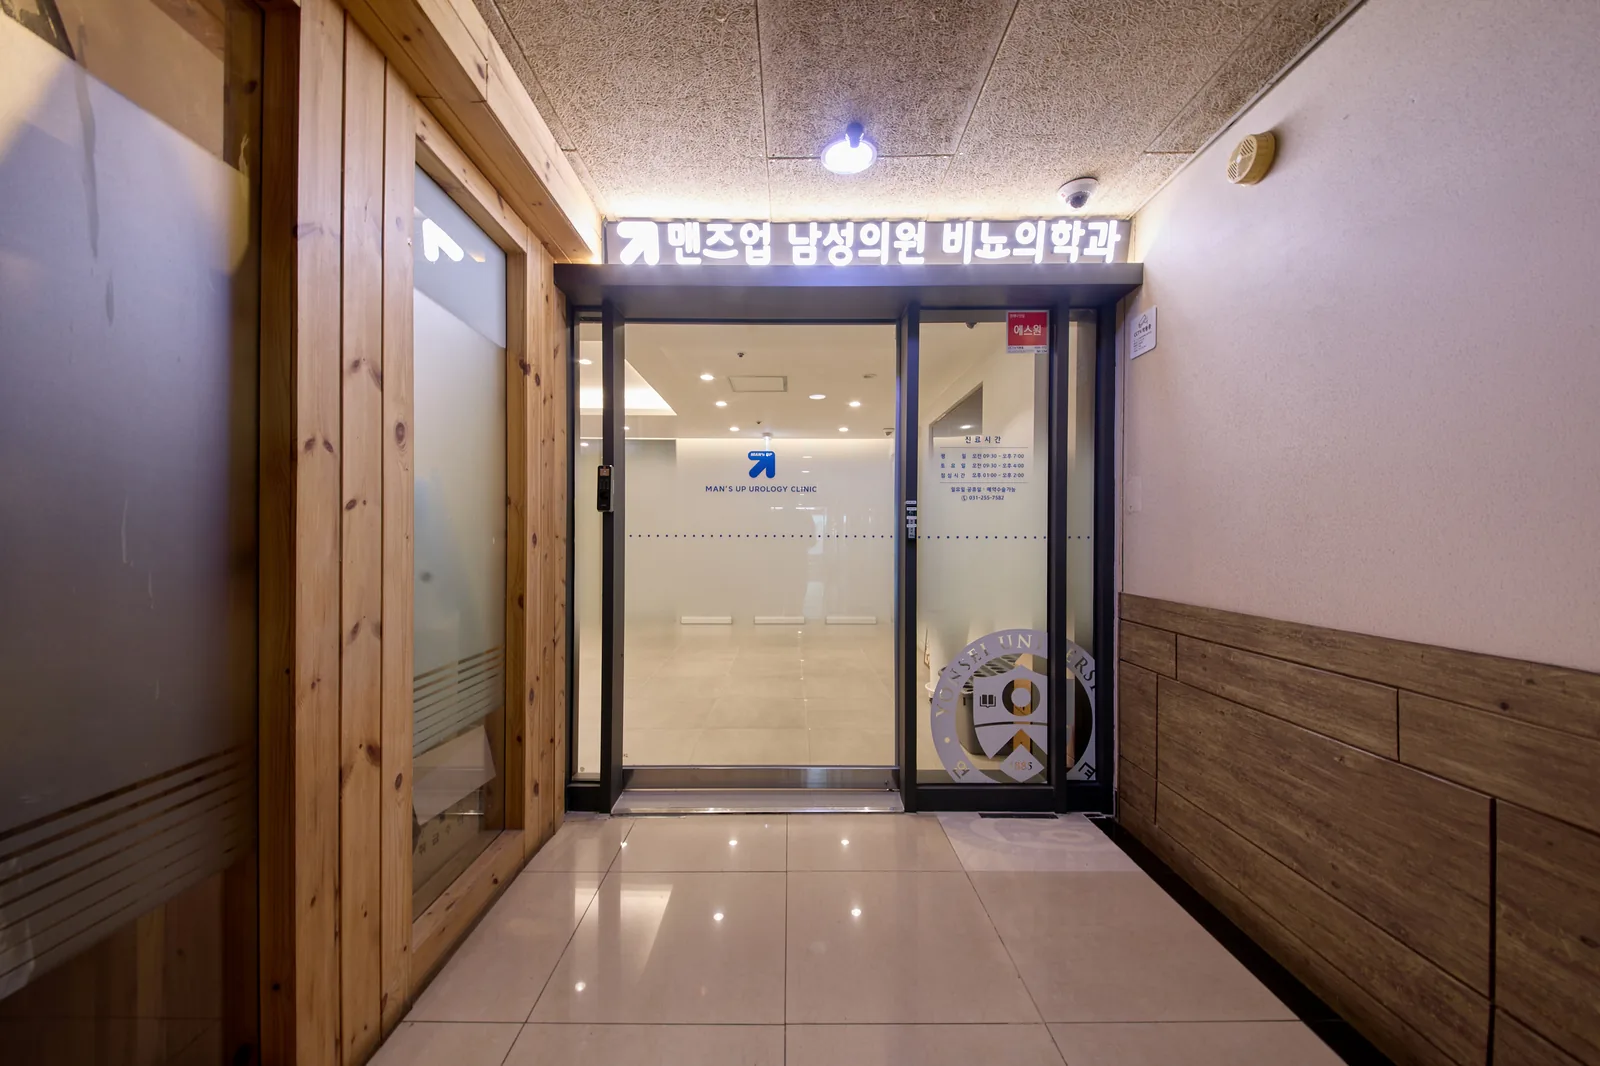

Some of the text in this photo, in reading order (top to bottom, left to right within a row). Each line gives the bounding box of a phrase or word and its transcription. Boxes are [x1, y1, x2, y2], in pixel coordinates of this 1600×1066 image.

[667, 220, 1121, 266] 맨즈업 남성의원 비뇨의학과
[1013, 324, 1042, 336] 에스원
[935, 643, 990, 718] YONSEI
